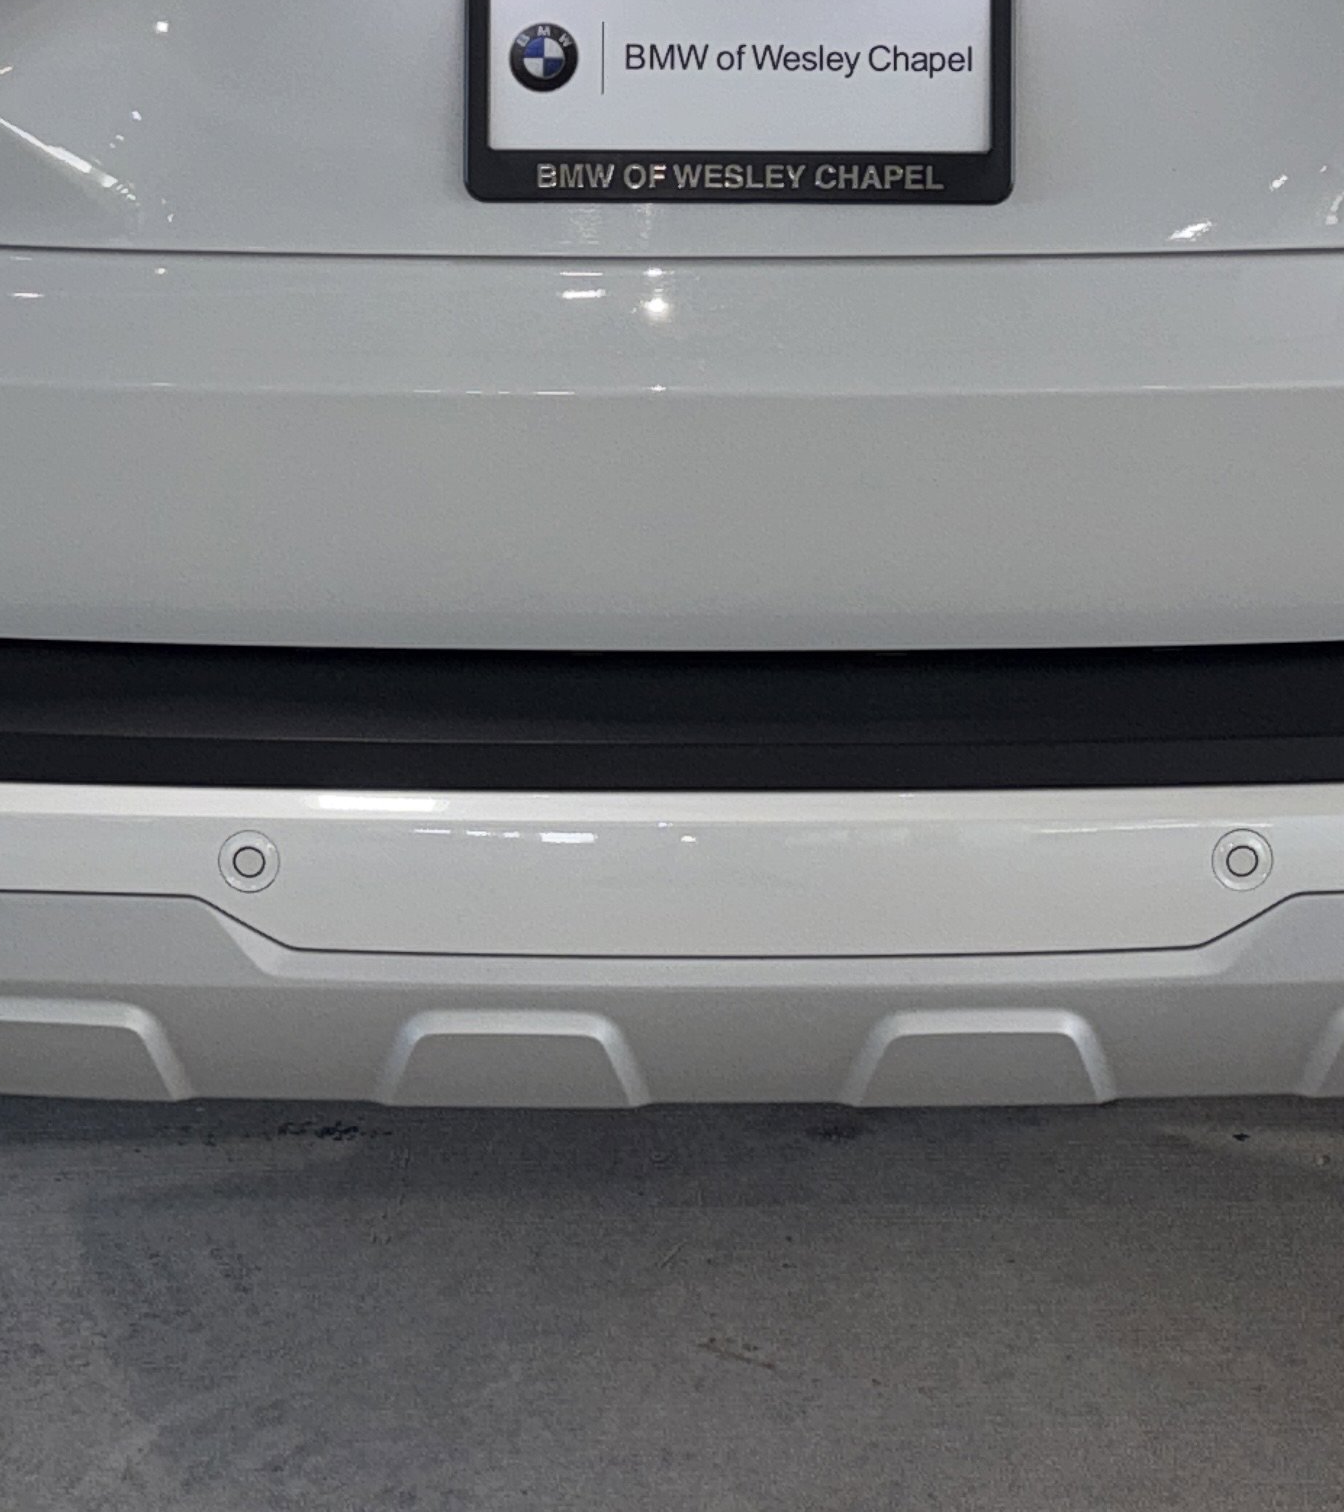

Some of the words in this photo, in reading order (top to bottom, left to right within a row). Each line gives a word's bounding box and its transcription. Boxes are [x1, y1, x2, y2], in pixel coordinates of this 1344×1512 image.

[516, 25, 573, 47] BMW
[625, 44, 709, 70] BMW
[716, 44, 747, 71] of
[751, 44, 861, 78] Wesley
[868, 45, 973, 78] Chapel
[537, 163, 615, 189] BMW
[623, 163, 667, 190] OF
[672, 163, 806, 189] WESLEY
[814, 164, 945, 190] CHAPEL
